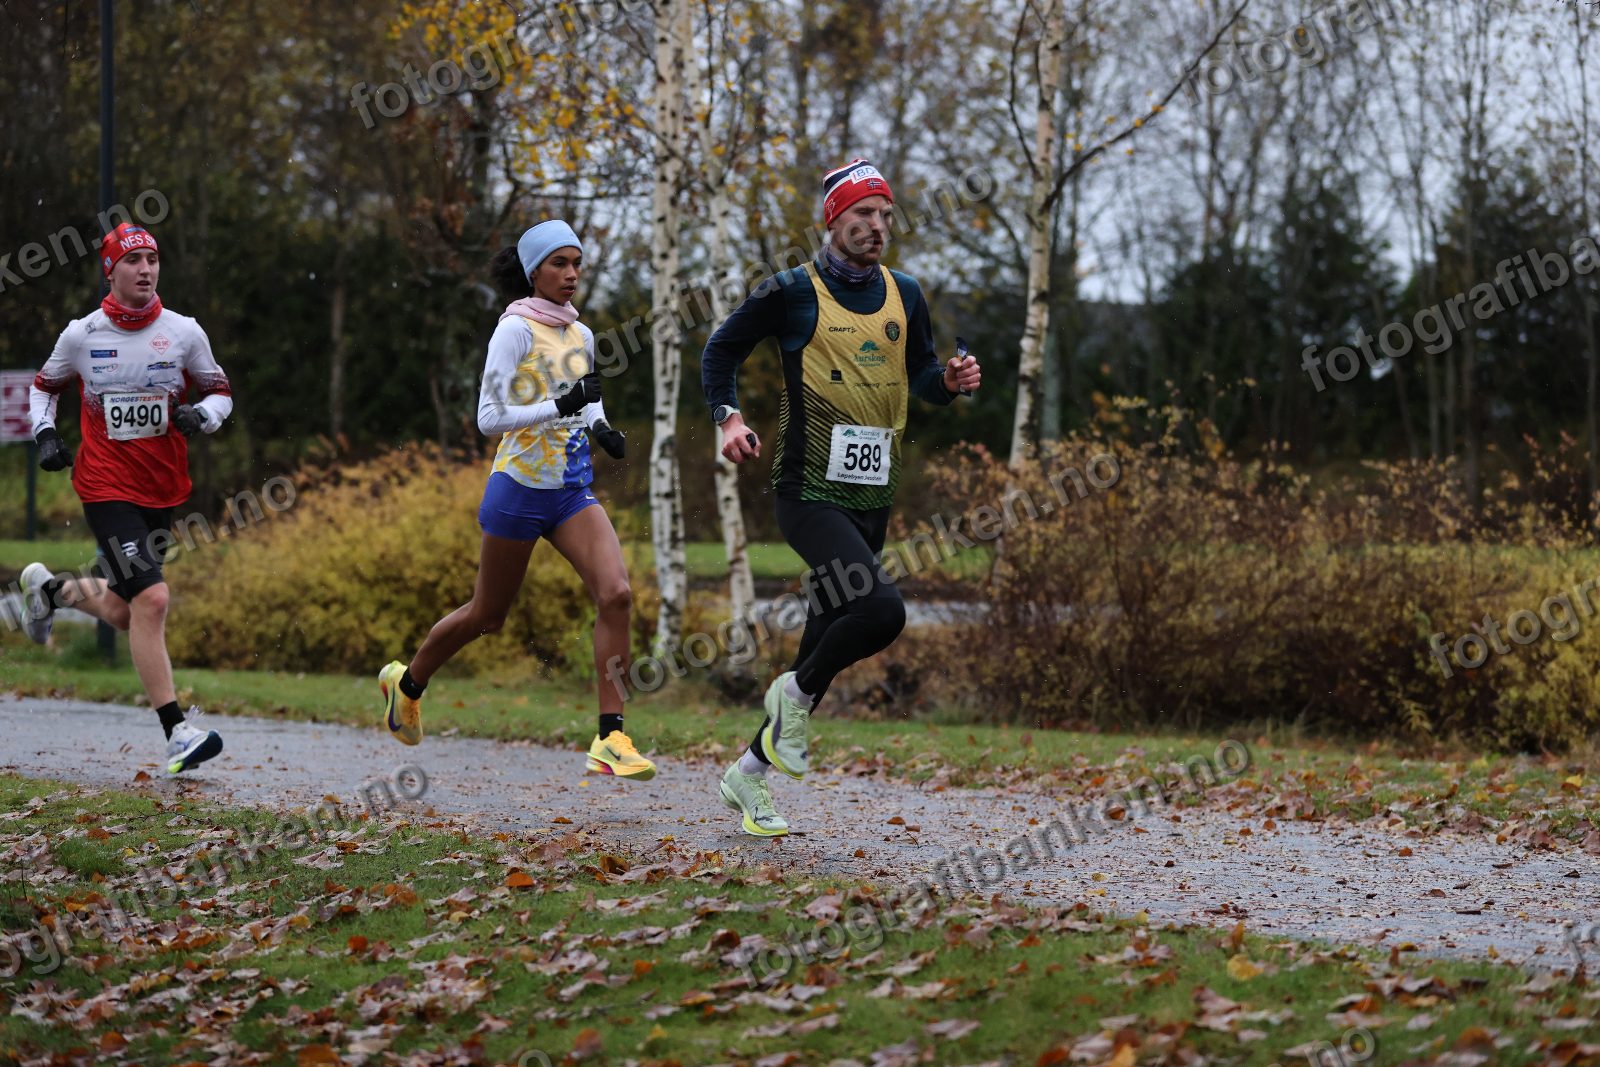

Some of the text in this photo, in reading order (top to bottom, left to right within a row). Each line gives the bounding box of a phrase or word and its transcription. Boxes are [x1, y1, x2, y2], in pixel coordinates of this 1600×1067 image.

[120, 234, 144, 252] NES
[110, 403, 162, 429] 9490
[843, 443, 882, 473] 589
